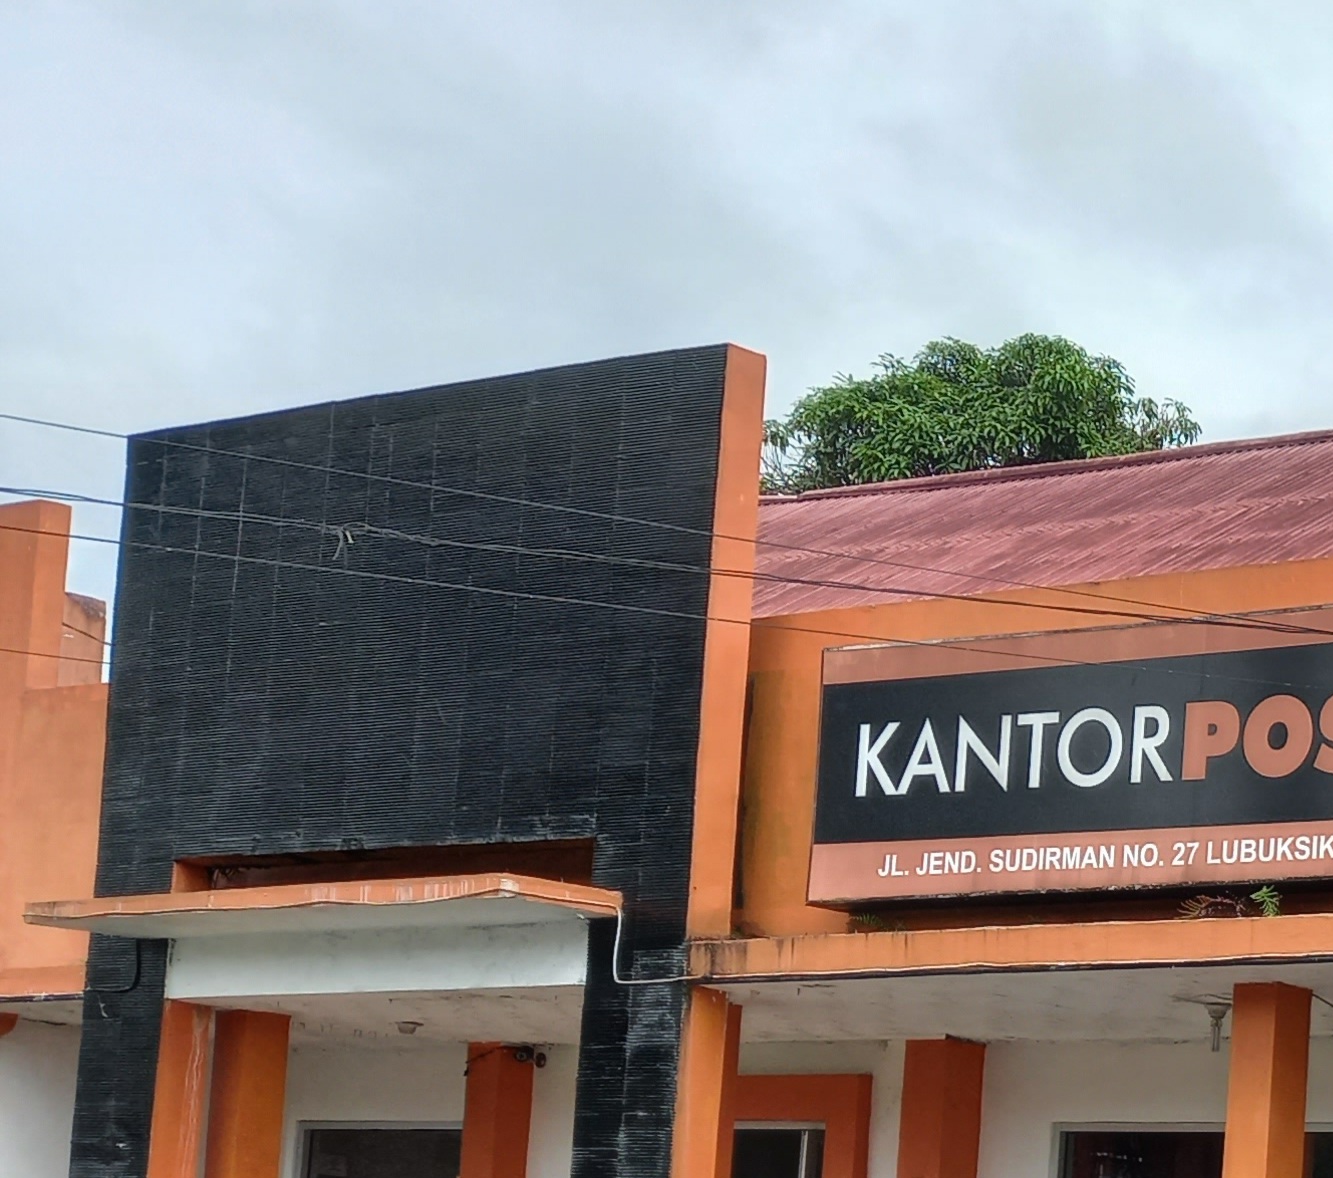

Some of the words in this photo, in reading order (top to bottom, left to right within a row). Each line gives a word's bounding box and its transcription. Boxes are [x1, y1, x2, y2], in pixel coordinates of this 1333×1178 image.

[877, 853, 909, 877] JL.
[915, 850, 982, 876] JEND.
[988, 844, 1116, 873] SUDIRMAN
[1121, 842, 1165, 869] NO.
[1171, 842, 1200, 867] 27
